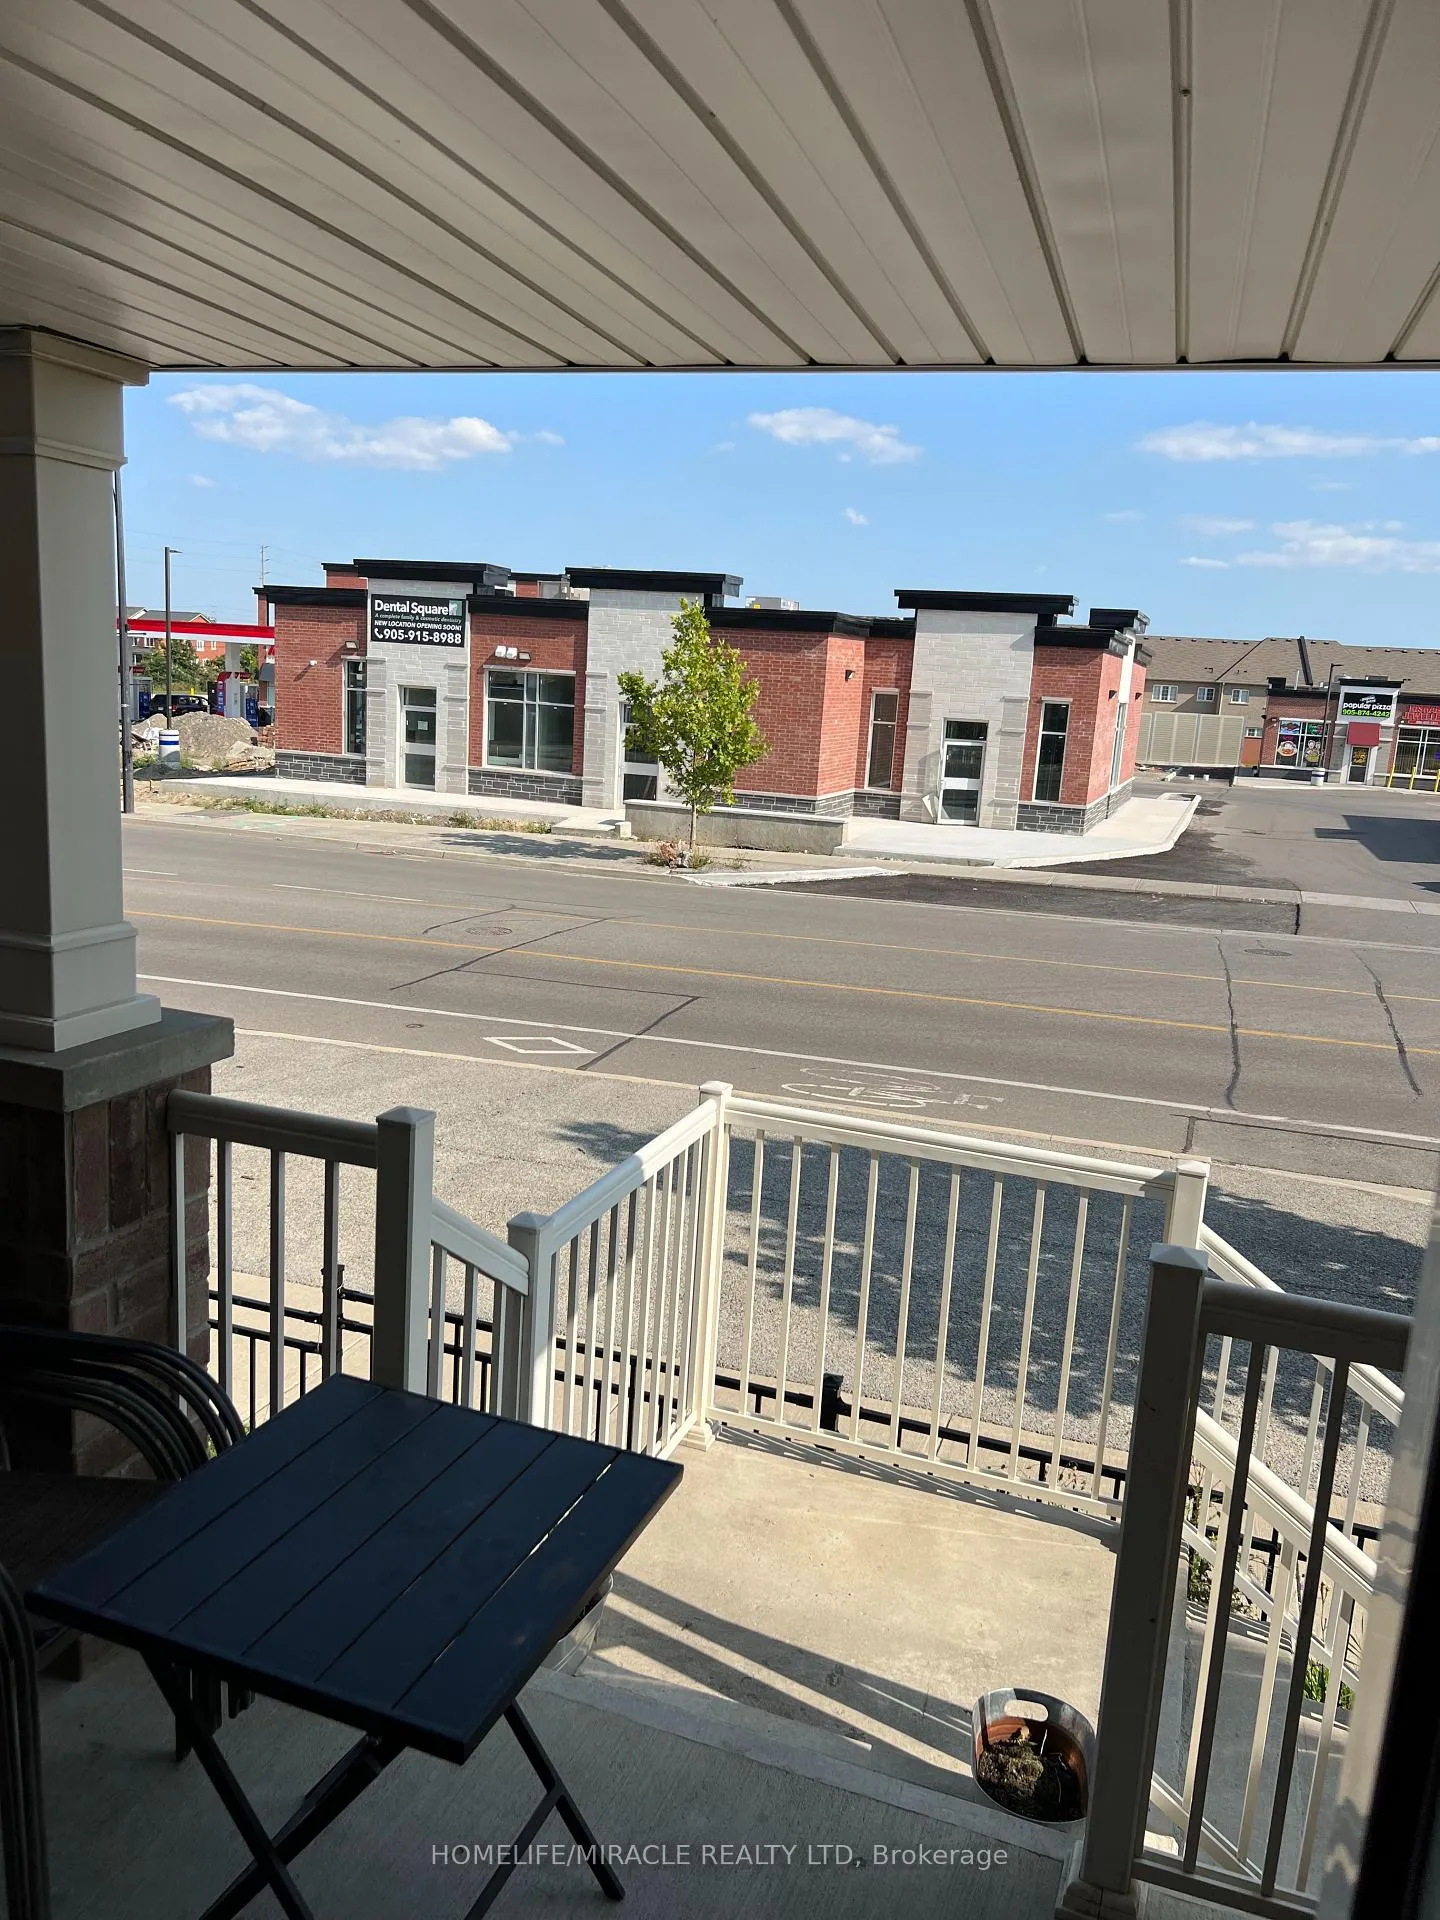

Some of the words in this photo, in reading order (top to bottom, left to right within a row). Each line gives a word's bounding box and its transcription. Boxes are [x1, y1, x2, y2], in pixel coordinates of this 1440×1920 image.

[374, 599, 410, 613] Dental
[411, 602, 449, 616] Square
[416, 622, 442, 630] OPENING
[383, 628, 462, 644] 905-915-8988
[1342, 709, 1390, 717] 905-874-4242
